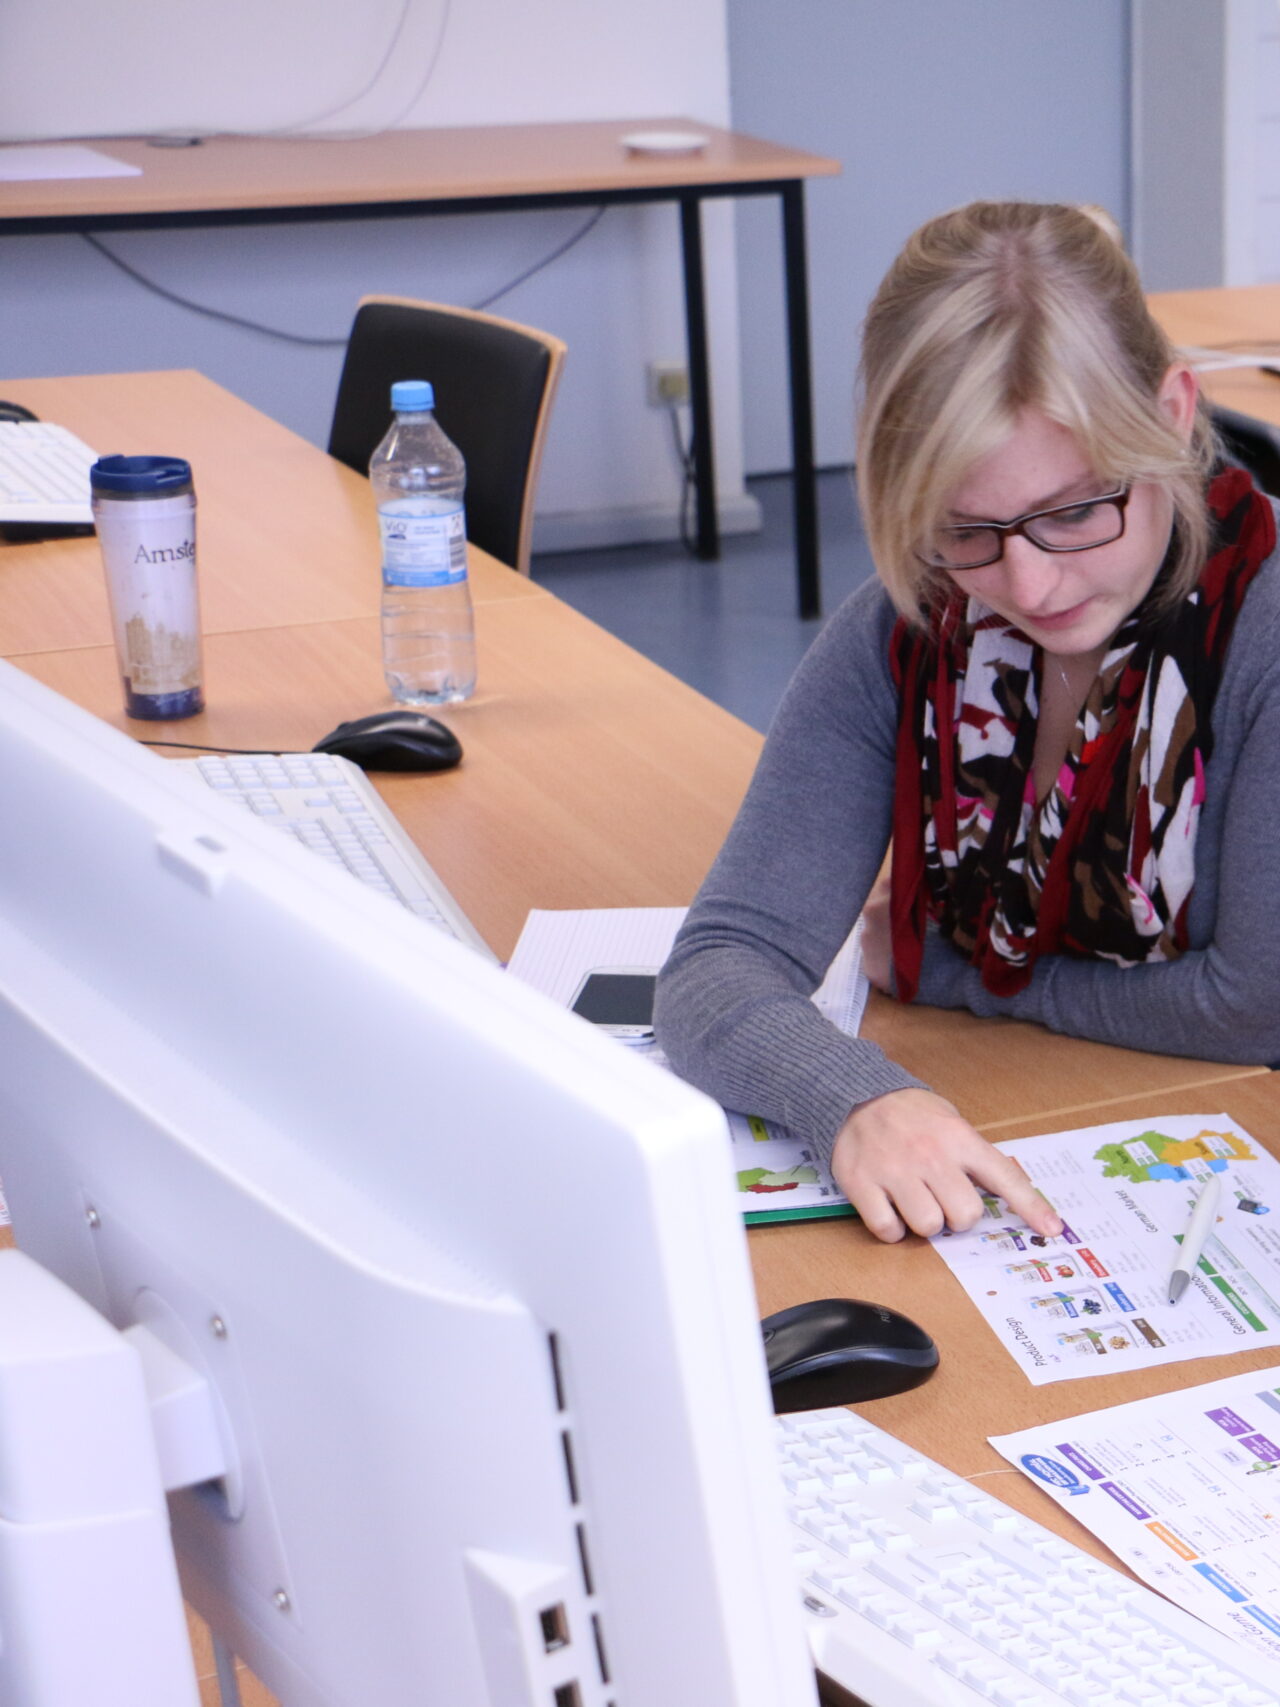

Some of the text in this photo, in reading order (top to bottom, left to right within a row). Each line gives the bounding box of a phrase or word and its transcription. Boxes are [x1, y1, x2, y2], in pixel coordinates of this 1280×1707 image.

[1112, 1189, 1160, 1233] German Market
[1214, 1309, 1248, 1335] General
[1000, 1316, 1050, 1367] Product Design
[1223, 1610, 1266, 1636] Game
